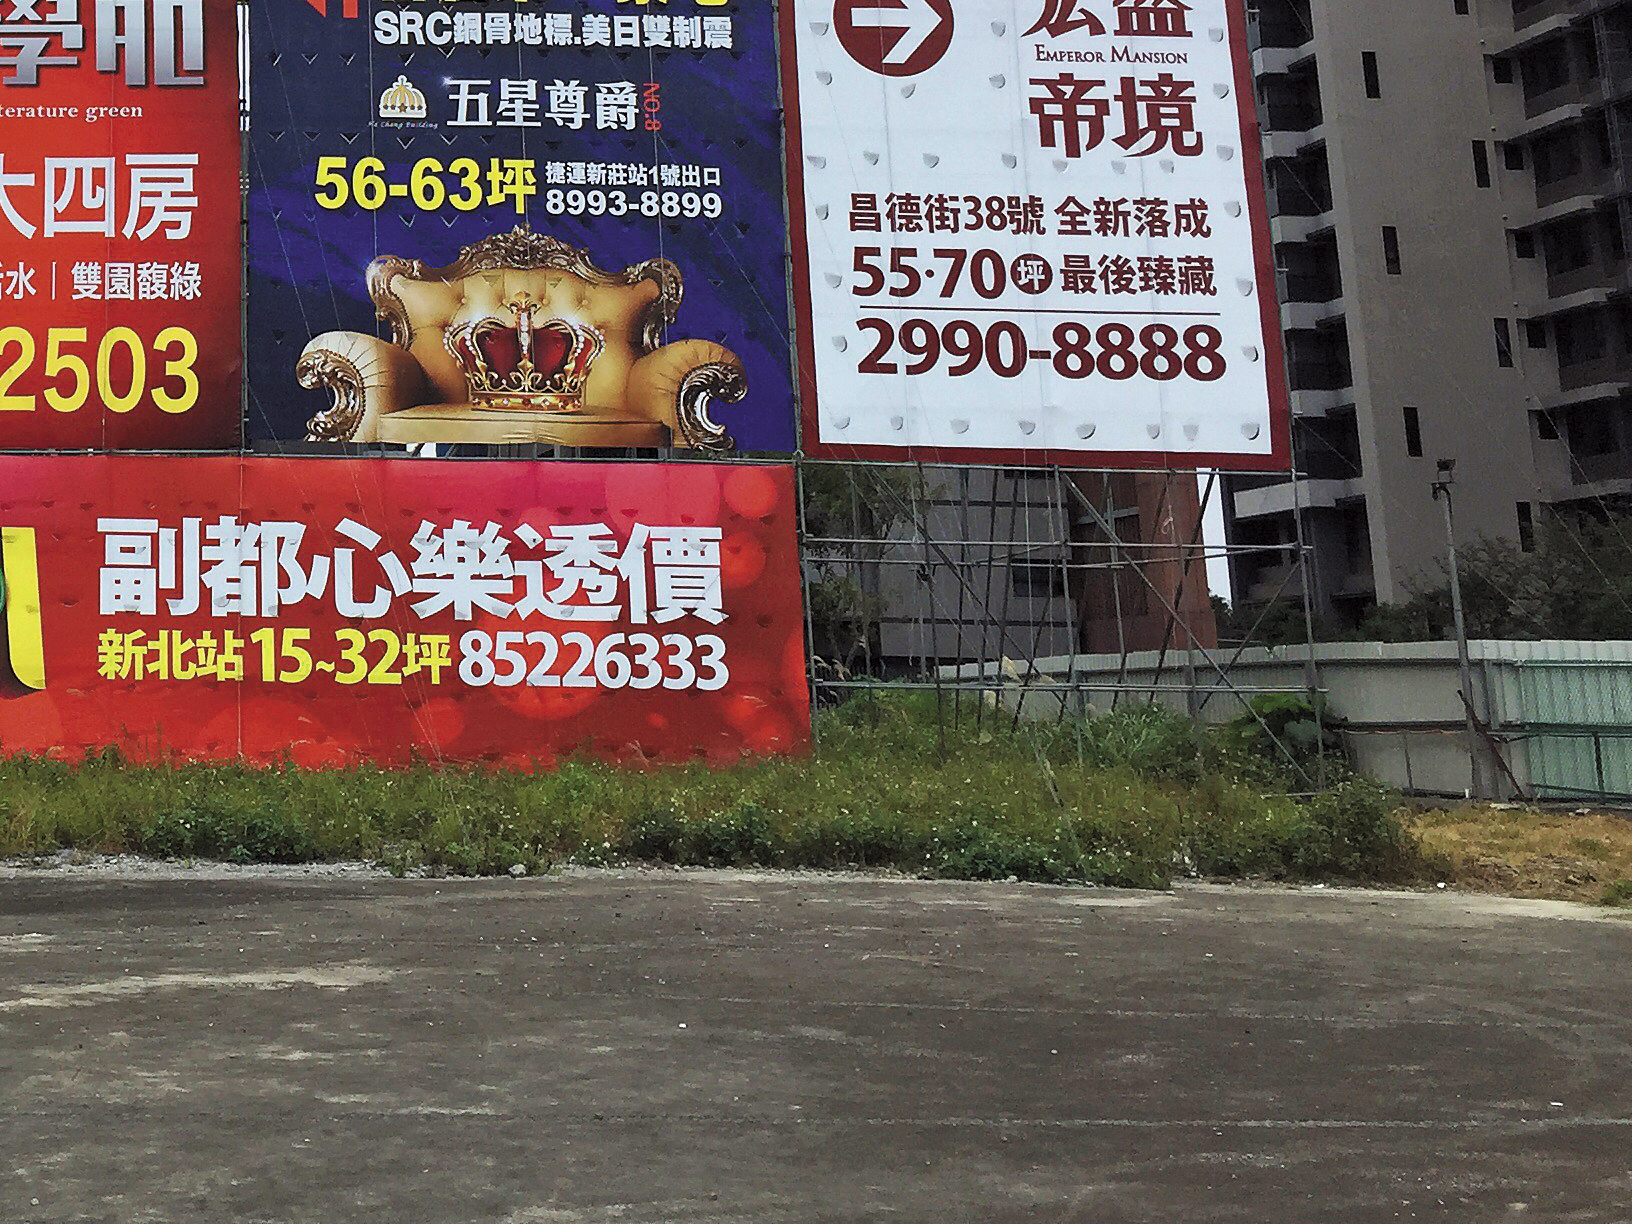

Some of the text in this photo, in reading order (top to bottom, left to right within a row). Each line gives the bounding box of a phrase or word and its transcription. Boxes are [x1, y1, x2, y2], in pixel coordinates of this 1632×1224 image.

[85, 106, 143, 123] green
[445, 77, 641, 132] 五星尊爵
[643, 82, 662, 131] NO.8
[1023, 72, 1204, 159] 帝境
[316, 156, 537, 213] 56-63坪
[544, 160, 721, 188] 捷運新莊站1號出口
[545, 188, 722, 219] 8993-8899
[848, 192, 1212, 239] 昌德街38號 全新落成
[70, 260, 202, 301] 雙園馥綠
[1059, 253, 1218, 297] 最後臻藏
[855, 317, 1227, 382] 2990-8888
[97, 515, 726, 626] 副都心樂透價
[97, 628, 245, 682] 新北站
[458, 629, 730, 691] 85226333
